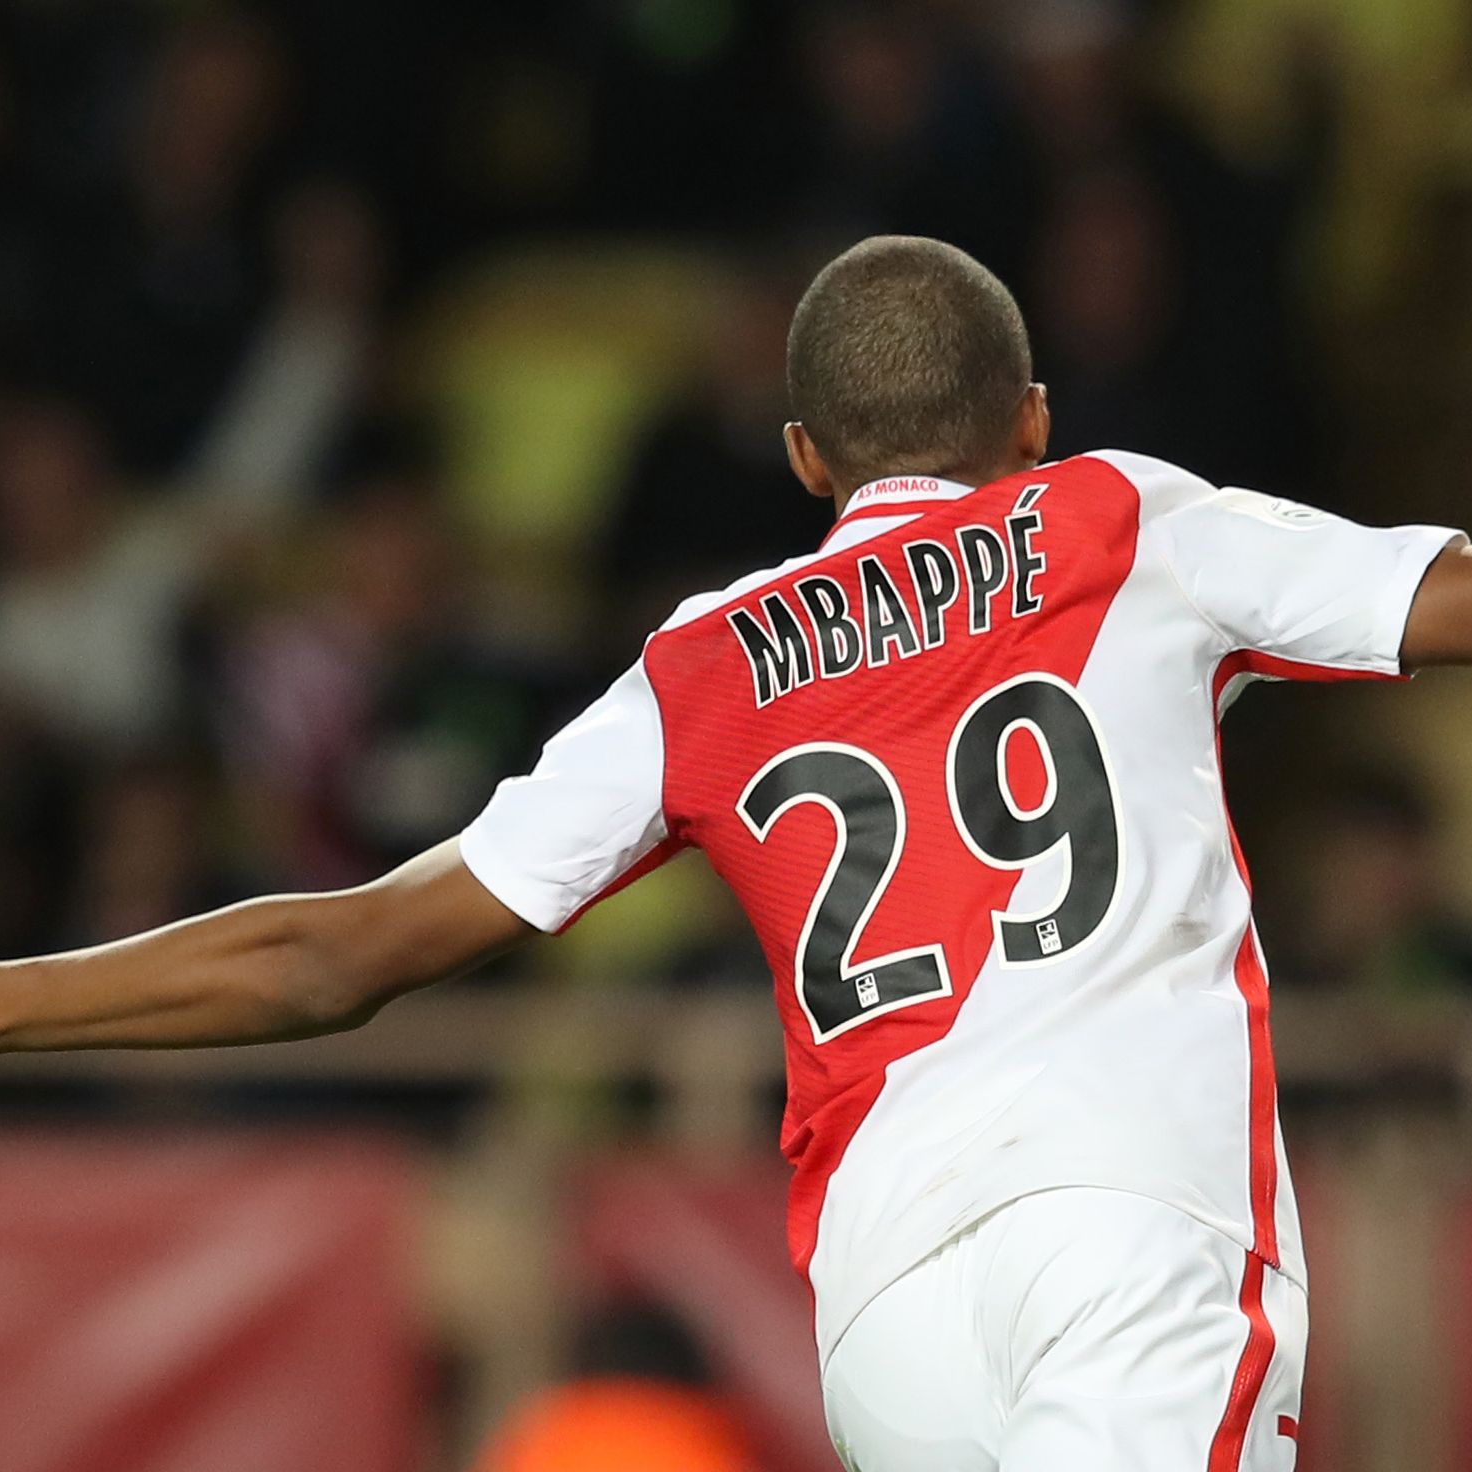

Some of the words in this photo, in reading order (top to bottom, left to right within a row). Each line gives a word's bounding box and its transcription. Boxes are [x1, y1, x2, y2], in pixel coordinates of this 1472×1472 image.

[725, 483, 1050, 709] MBAPPÉ
[857, 486, 872, 500] AS
[875, 479, 939, 495] MONACO
[734, 671, 1128, 1045] 29
